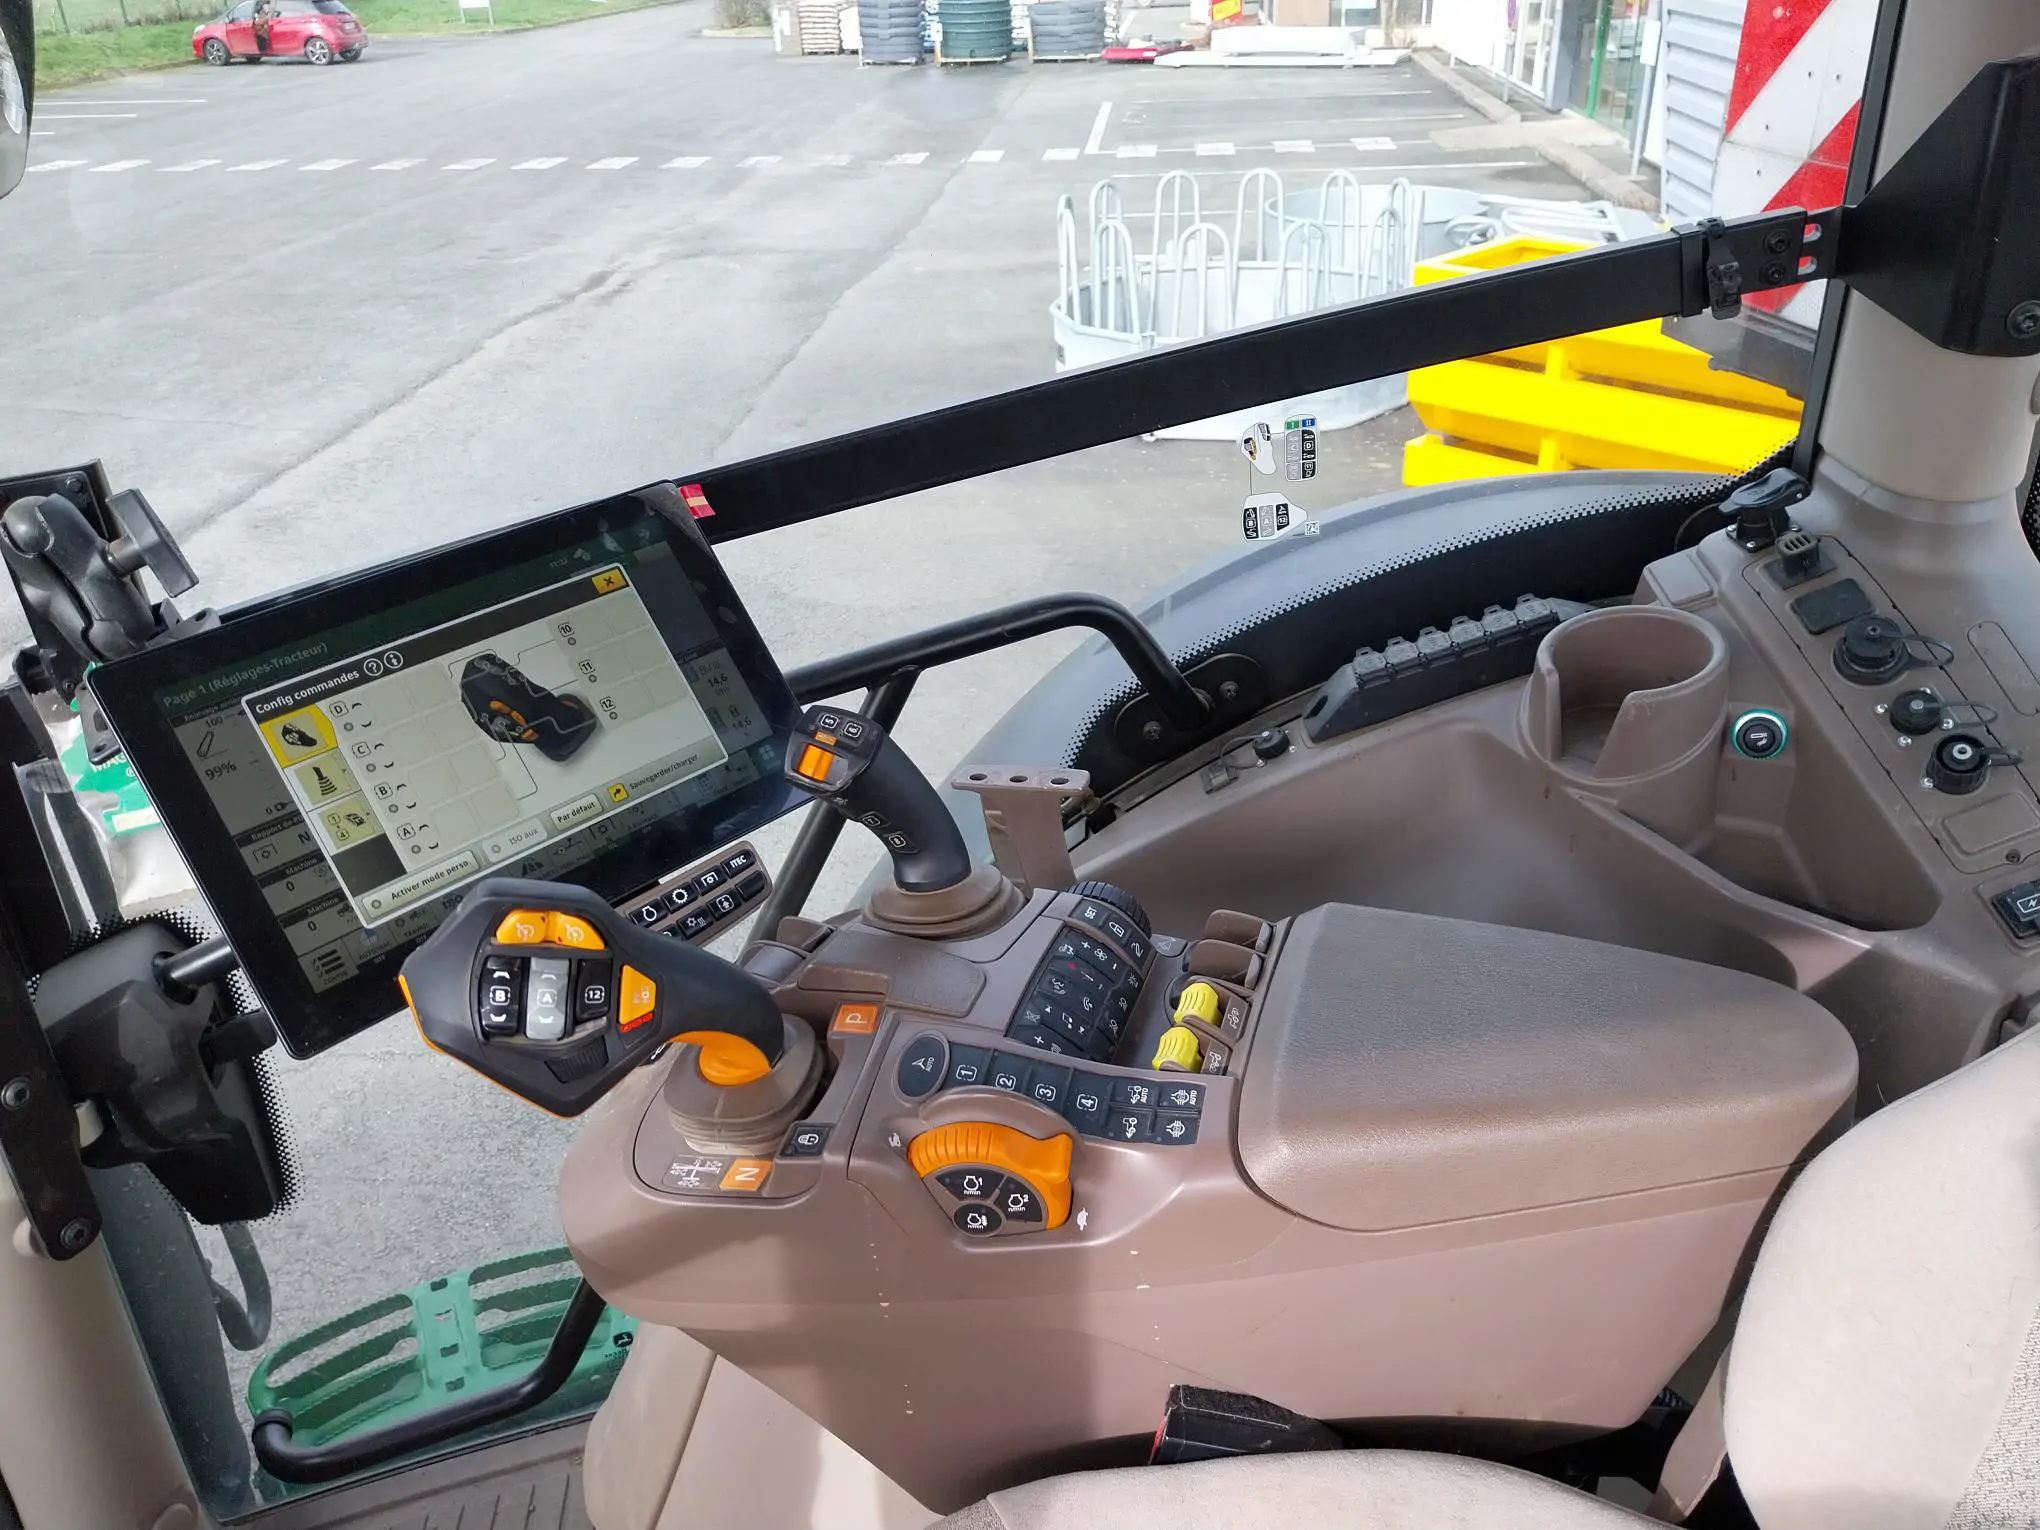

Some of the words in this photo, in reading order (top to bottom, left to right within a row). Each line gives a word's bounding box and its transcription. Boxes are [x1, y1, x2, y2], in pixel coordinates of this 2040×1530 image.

[560, 624, 572, 635] 10
[580, 661, 593, 672] 11
[163, 689, 198, 708] Page
[201, 682, 208, 695] 1
[209, 642, 328, 693] (Réglages-Tracteur)
[255, 696, 294, 714] Config
[294, 670, 360, 701] commandes
[333, 704, 343, 715] D
[602, 698, 613, 709] 12
[824, 717, 834, 725] 5
[848, 726, 858, 734] 6
[356, 745, 365, 755] C
[205, 762, 237, 781] 99%
[628, 754, 699, 791] Sauvegarder/charger
[379, 786, 388, 797] B
[557, 811, 571, 824] Par
[571, 800, 596, 818] défaut
[251, 823, 283, 841] Rapport
[298, 831, 312, 844] N
[402, 827, 411, 837] A
[524, 828, 540, 841] aux
[285, 858, 318, 876] Machine
[729, 854, 748, 869] ITEC
[286, 880, 296, 892] 0
[391, 881, 420, 901] Activer
[422, 869, 446, 887] mode
[446, 861, 472, 880] perso.
[307, 897, 339, 915] Machine
[1085, 906, 1097, 919] SET
[307, 920, 317, 932] 0
[495, 991, 506, 1002] B
[542, 993, 552, 1004] A
[588, 990, 602, 1000] 12
[845, 1012, 867, 1024] P
[925, 1056, 935, 1072] AUTO
[960, 1066, 974, 1078] 1
[1000, 1076, 1013, 1088] 2
[1039, 1086, 1052, 1098] 3
[1139, 1087, 1148, 1104] AUTO
[1189, 1089, 1198, 1105] AUTO
[1081, 1095, 1095, 1109] 4
[734, 1167, 760, 1181] N
[977, 1177, 983, 1186] 1
[963, 1188, 982, 1197] n/min
[1022, 1194, 1029, 1203] 2
